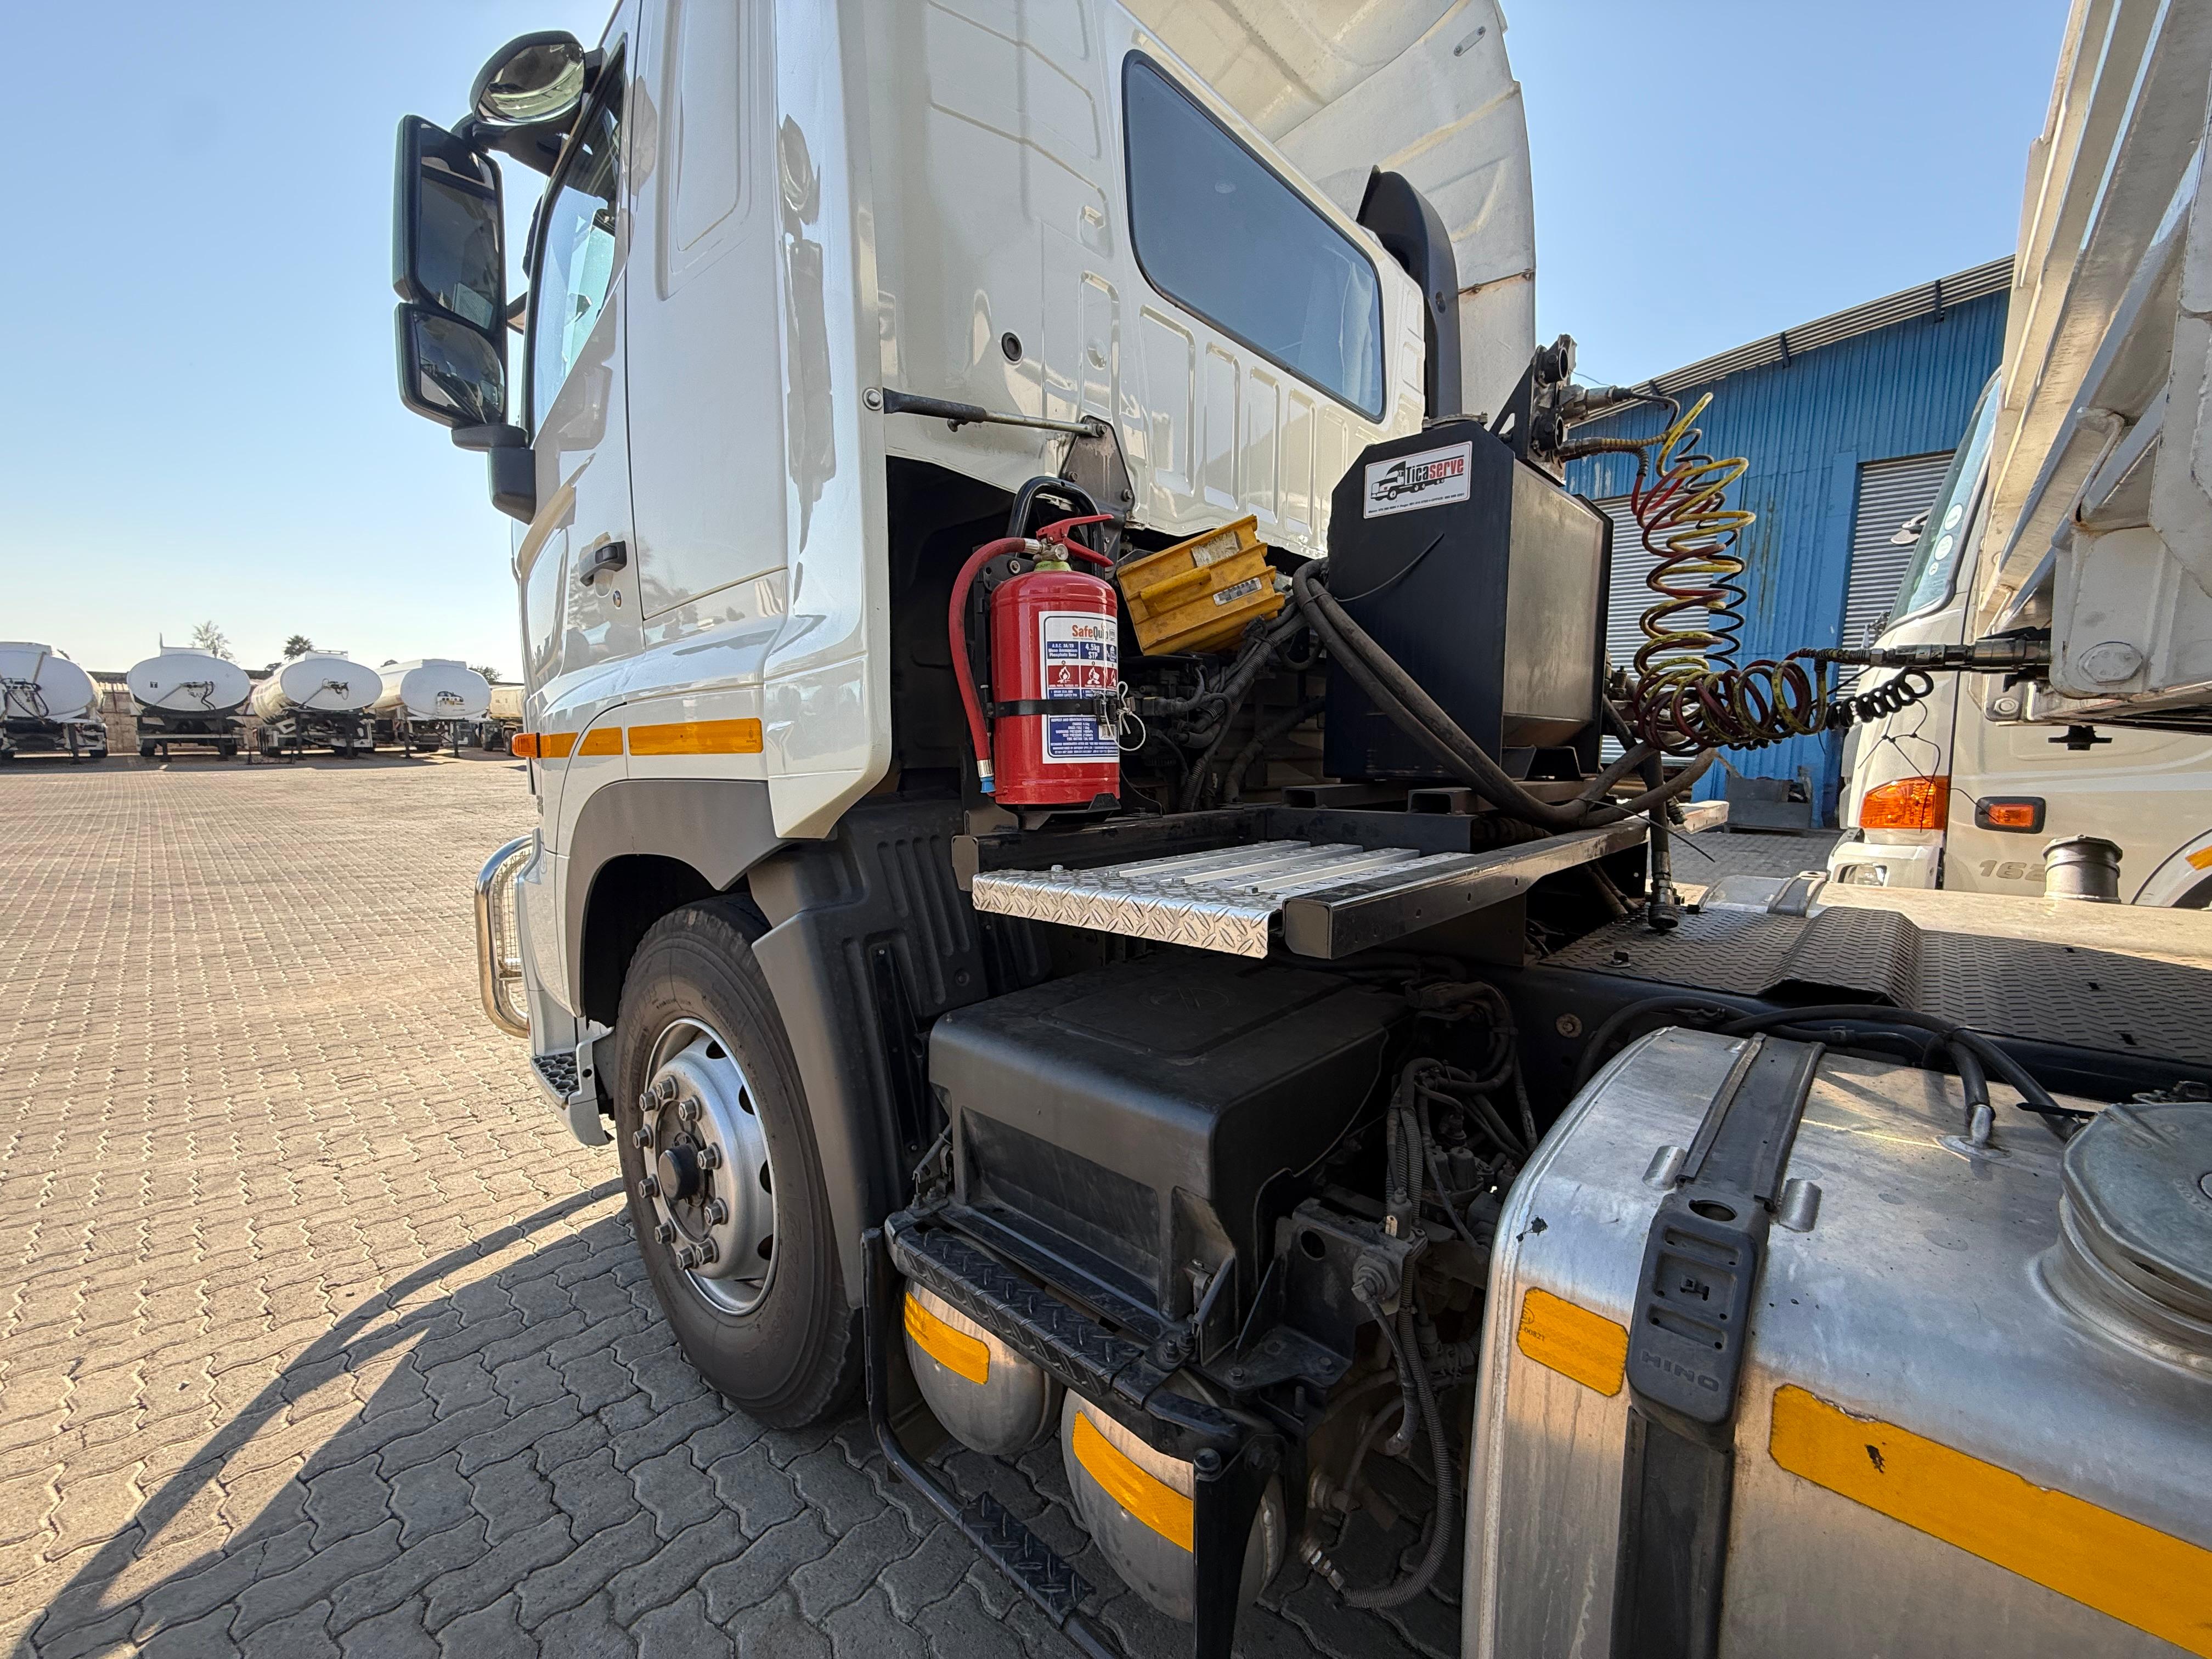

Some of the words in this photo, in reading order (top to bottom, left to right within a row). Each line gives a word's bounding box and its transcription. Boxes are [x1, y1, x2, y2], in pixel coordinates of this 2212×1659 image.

[1406, 458, 1464, 484] Ticaserve
[1085, 643, 1100, 653] 4.5kg
[1088, 651, 1098, 659] STP
[1641, 1350, 1720, 1392] HINO
